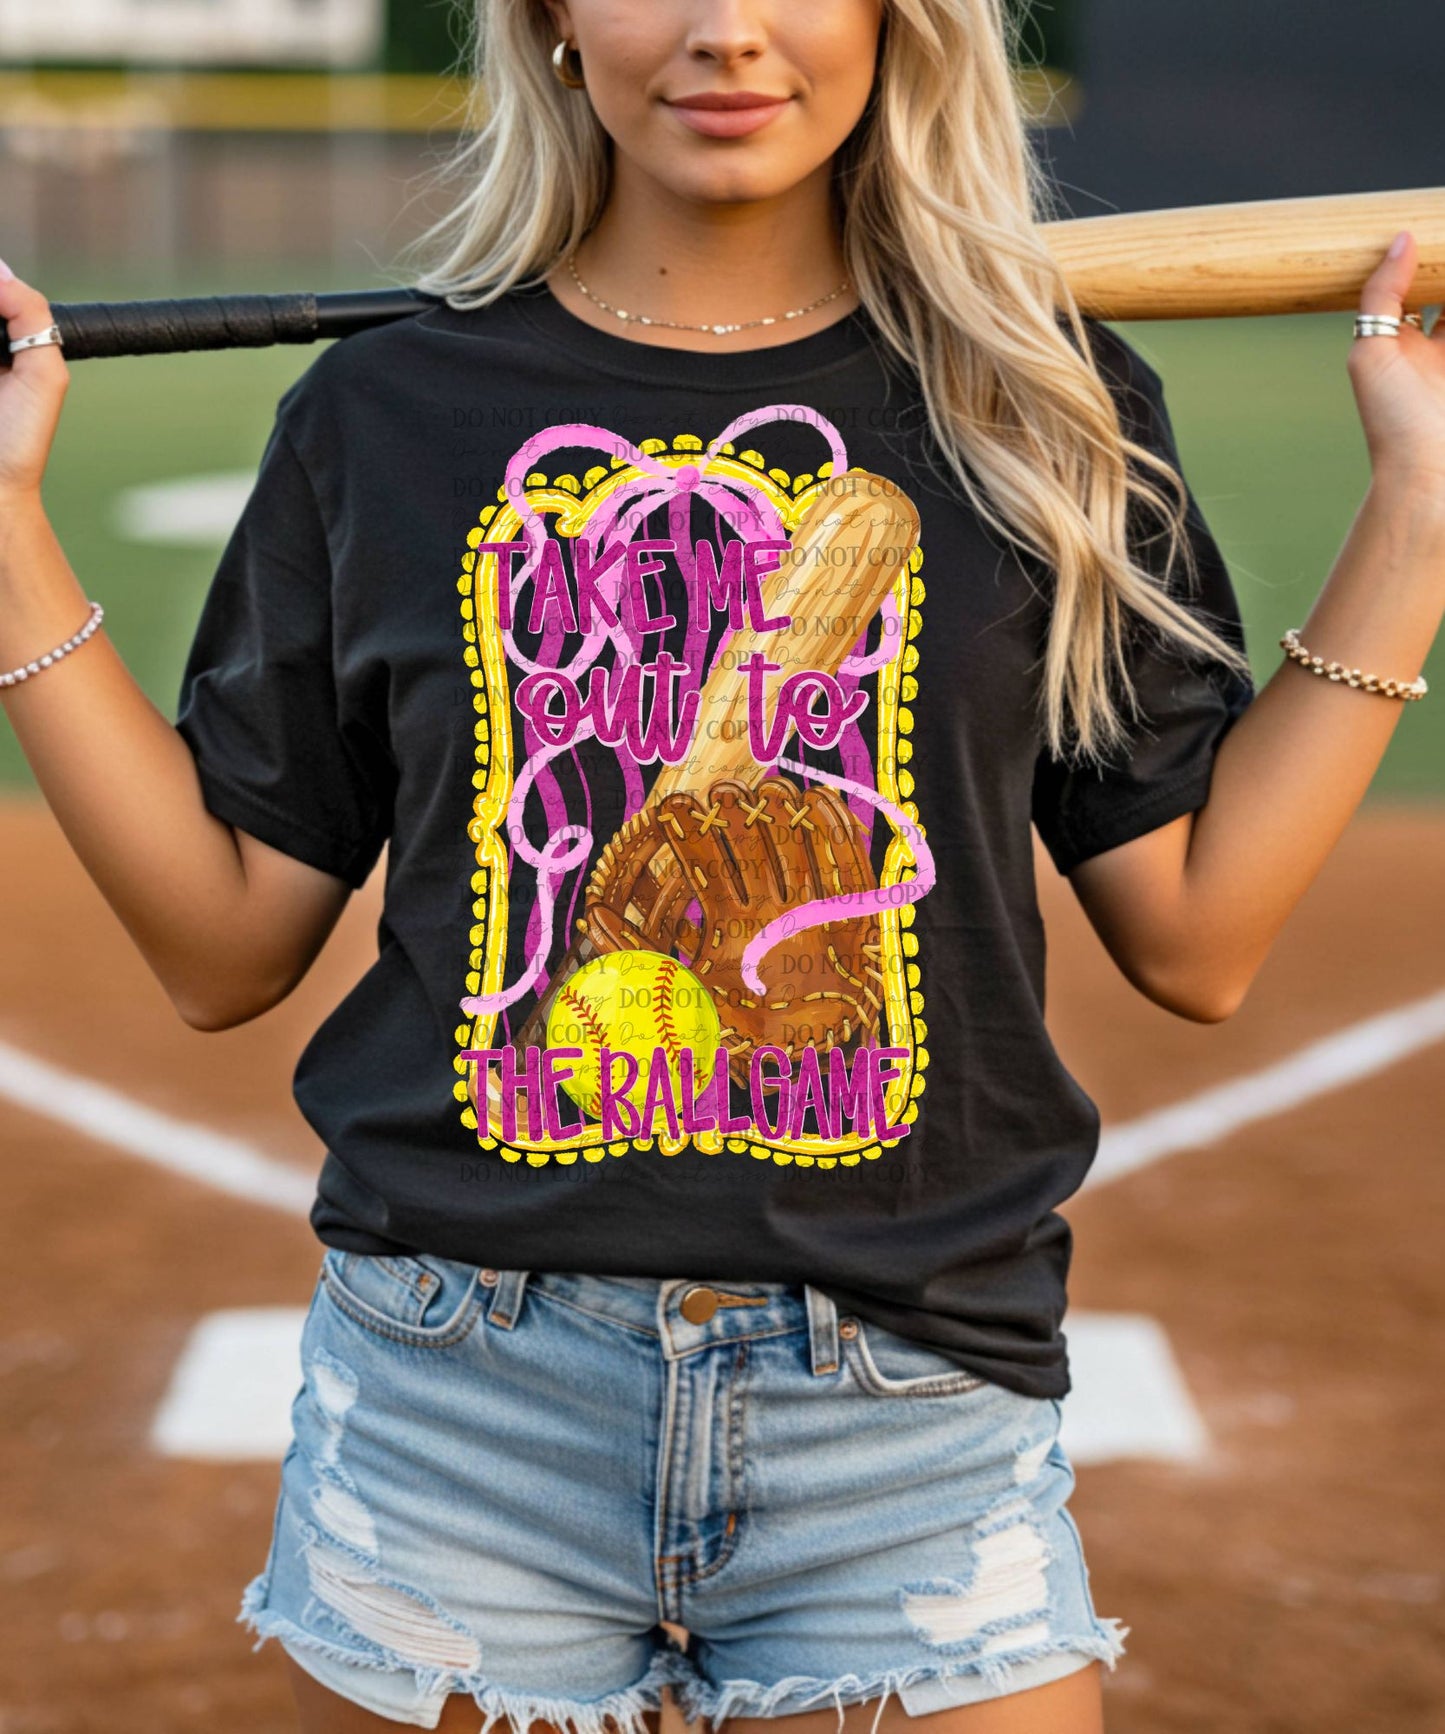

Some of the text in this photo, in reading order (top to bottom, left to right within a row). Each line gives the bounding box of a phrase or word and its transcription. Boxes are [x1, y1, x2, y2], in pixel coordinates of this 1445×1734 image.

[478, 539, 793, 635] TAKE ME
[515, 651, 871, 767] out to
[460, 1045, 584, 1143] THE
